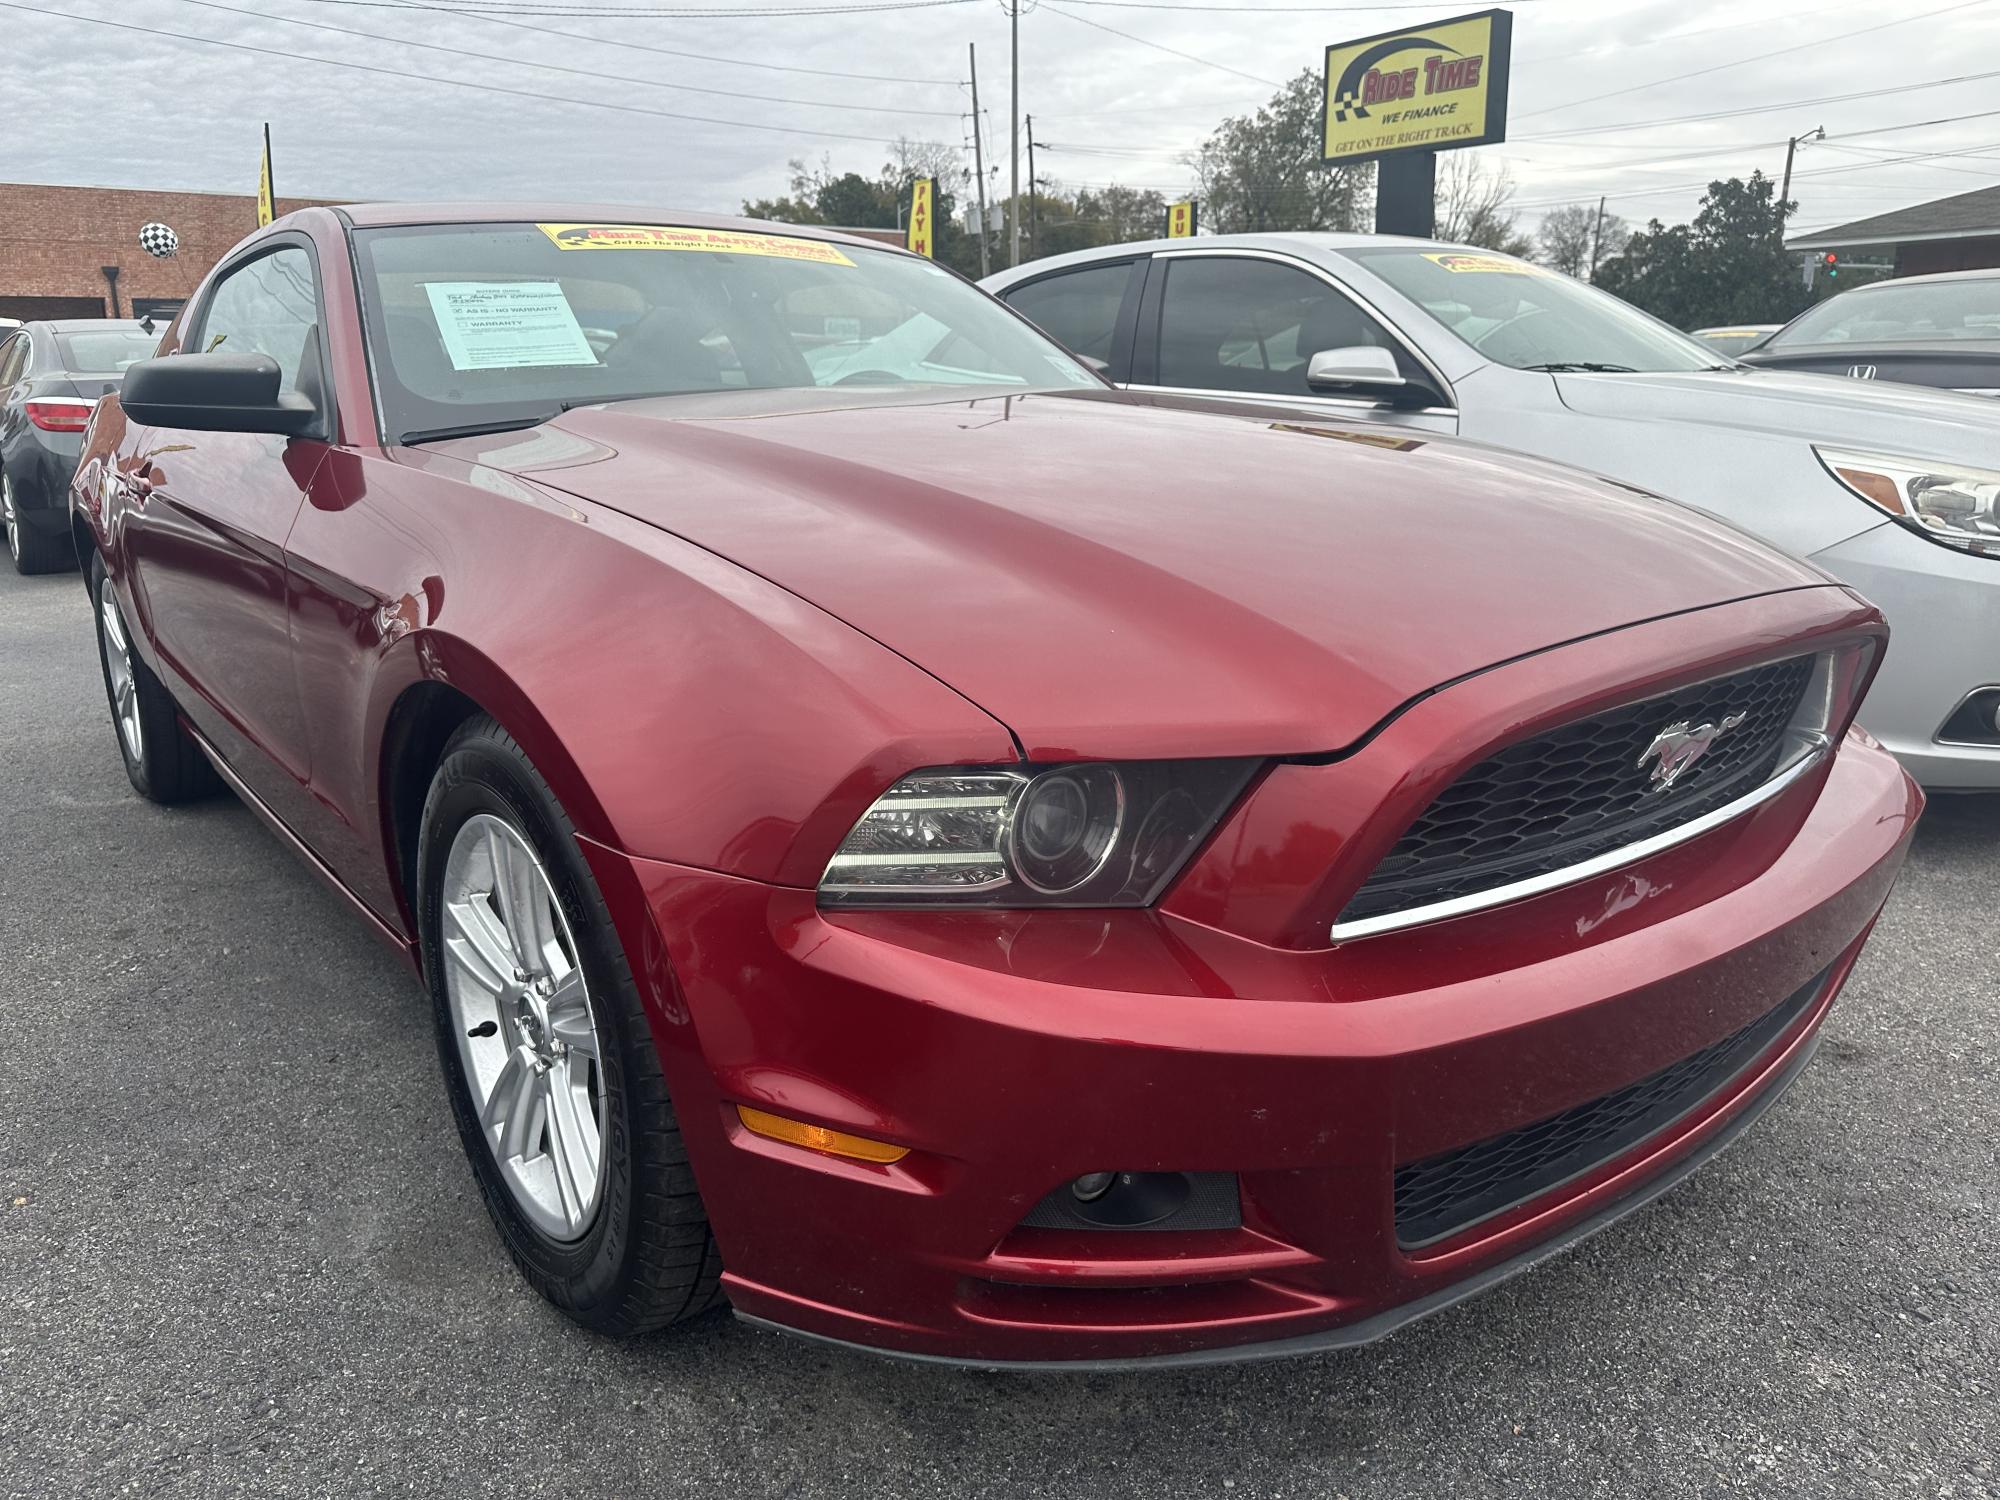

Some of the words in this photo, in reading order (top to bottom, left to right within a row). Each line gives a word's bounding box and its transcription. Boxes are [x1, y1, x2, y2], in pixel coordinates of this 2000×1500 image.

[1362, 68, 1418, 106] RIDE
[1425, 55, 1483, 94] TIME
[1382, 113, 1400, 125] WE
[1402, 103, 1458, 121] FINANCE
[1335, 140, 1357, 153] GET
[1358, 138, 1374, 150] ON
[1375, 134, 1397, 147] THE
[1397, 130, 1433, 144] RIGHT
[1435, 123, 1473, 138] TRACK
[916, 186, 925, 232] PAY
[588, 229, 645, 240] RIDE
